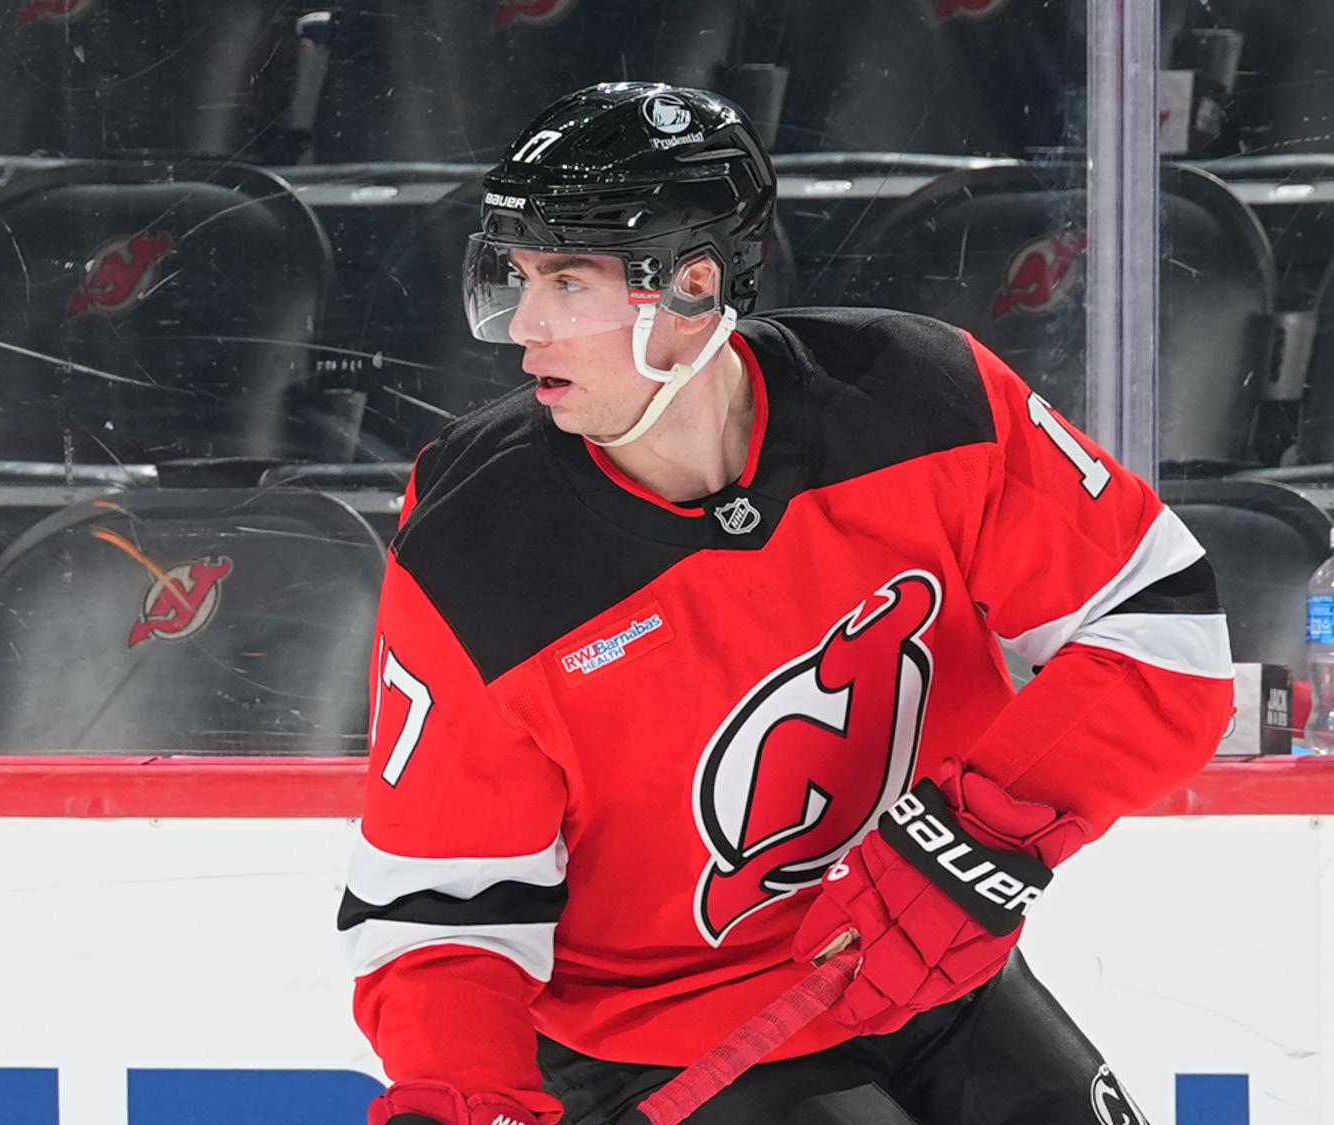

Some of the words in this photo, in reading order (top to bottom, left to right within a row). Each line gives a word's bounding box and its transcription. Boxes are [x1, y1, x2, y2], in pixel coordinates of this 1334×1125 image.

[512, 129, 563, 163] 17
[649, 131, 705, 150] Prudential
[484, 193, 527, 209] BAUER
[1028, 390, 1111, 499] 1
[730, 506, 748, 530] NHL
[563, 614, 662, 671] RWJBarnabas
[581, 648, 626, 674] HEALTH
[885, 792, 1044, 918] BAUER
